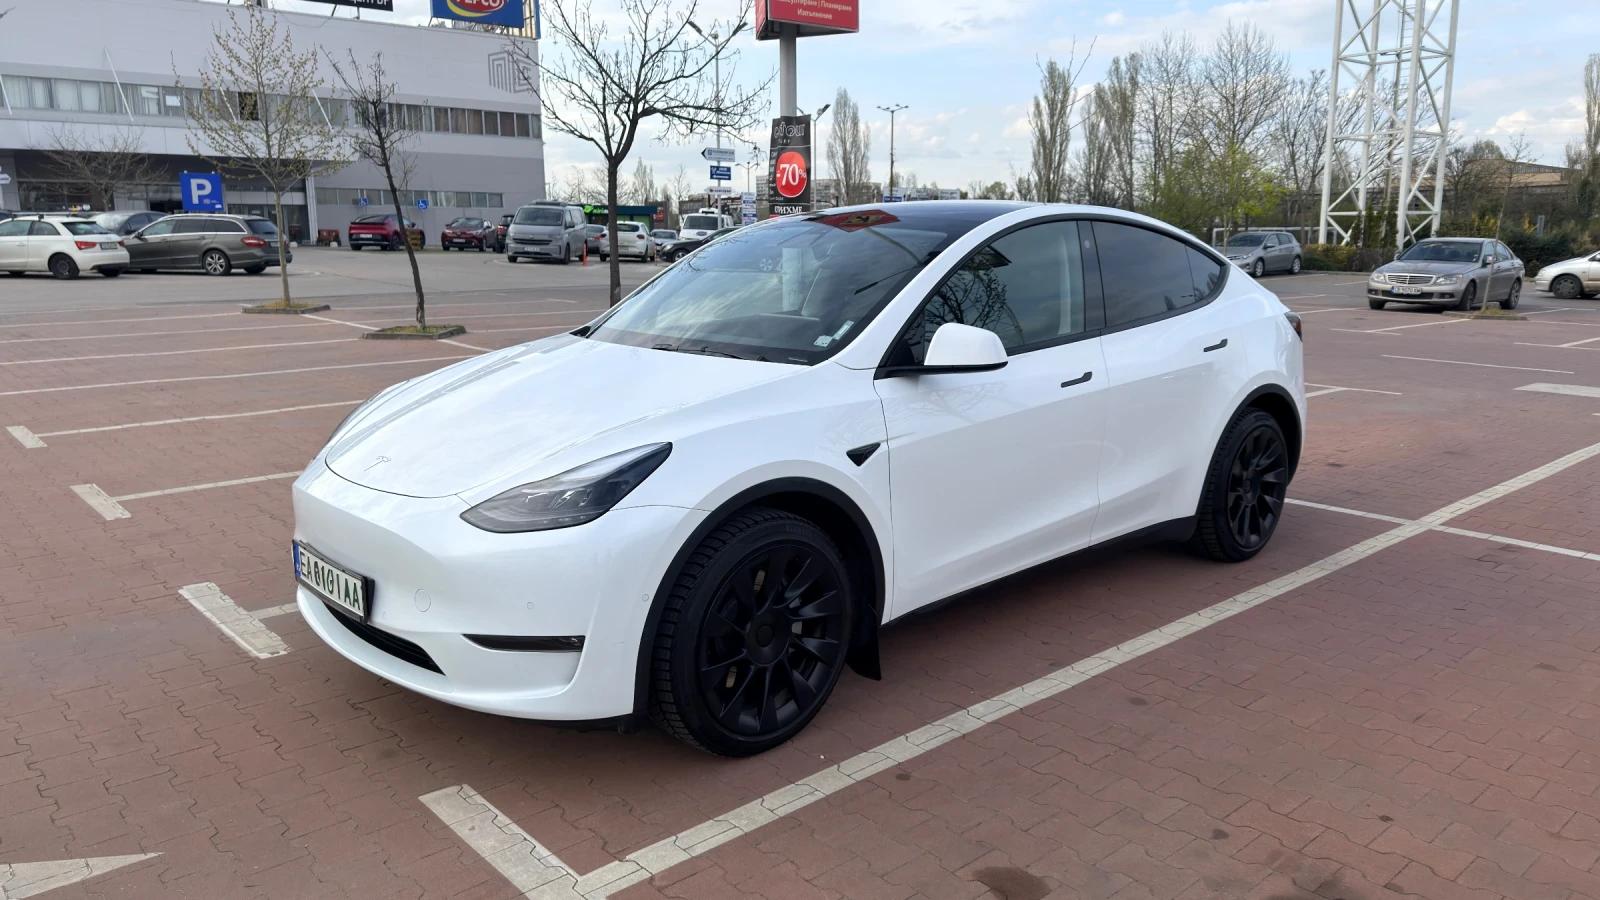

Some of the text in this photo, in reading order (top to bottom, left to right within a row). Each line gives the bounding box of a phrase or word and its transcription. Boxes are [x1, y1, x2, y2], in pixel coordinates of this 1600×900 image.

[797, 8, 833, 20] Изпълнение
[820, 1, 852, 12] Планиране
[776, 163, 807, 186] -70%
[190, 178, 212, 205] P
